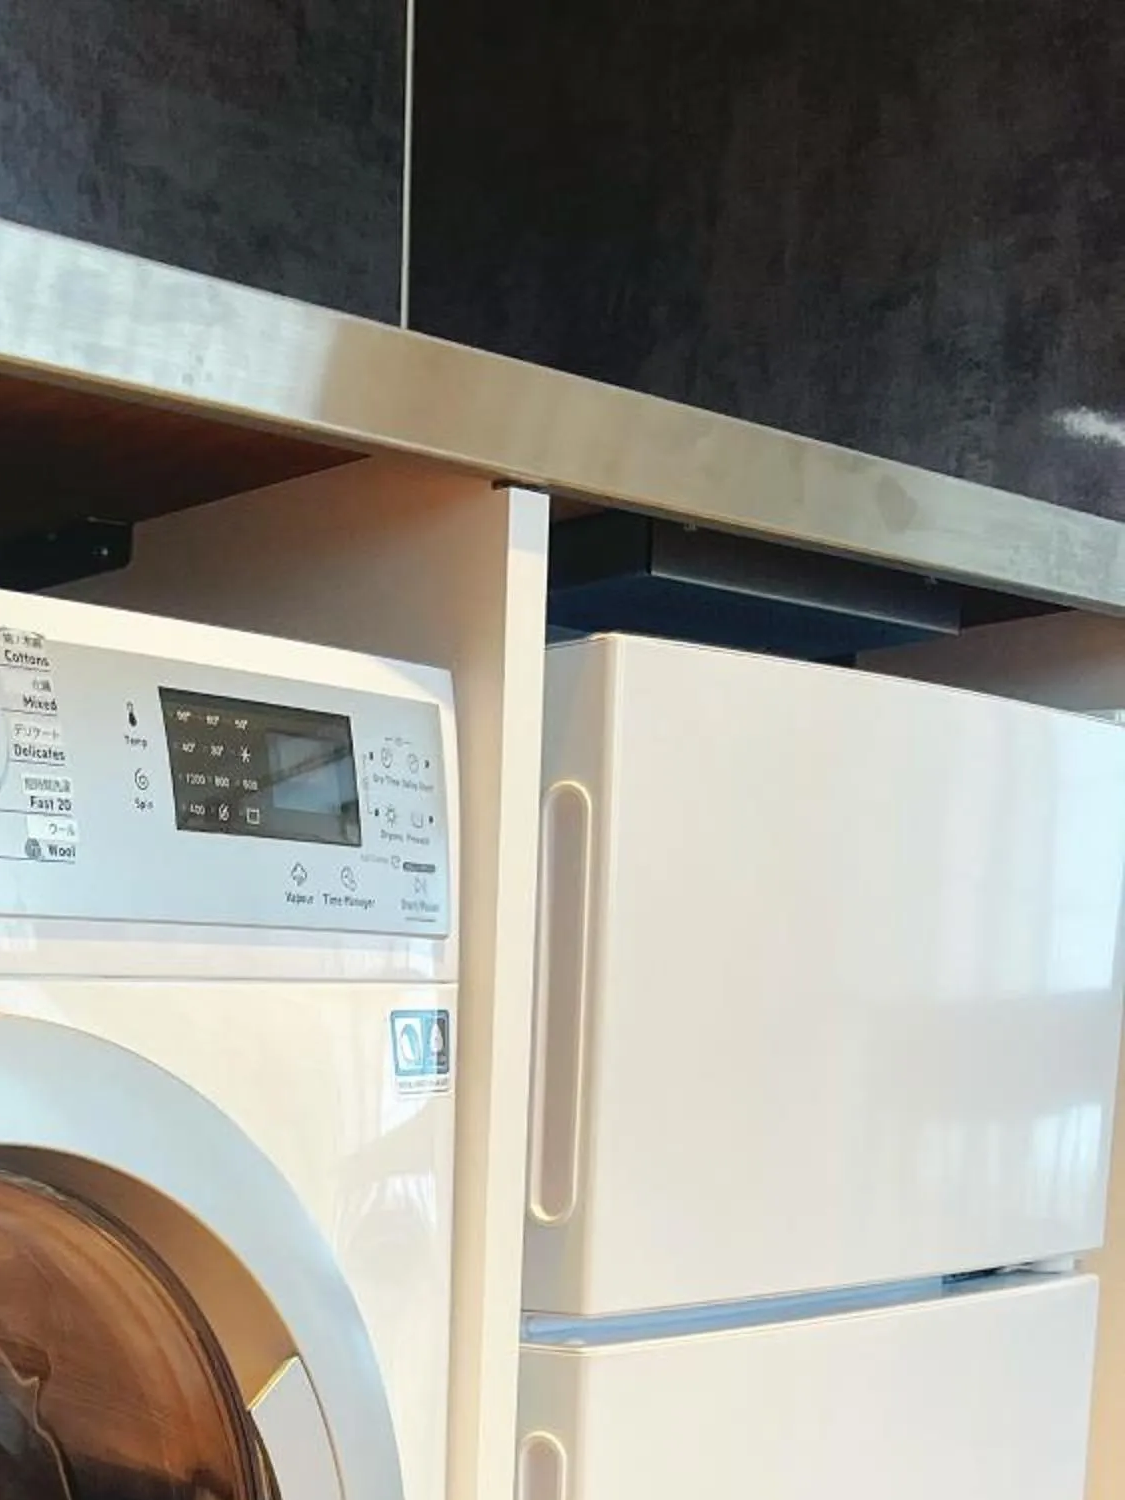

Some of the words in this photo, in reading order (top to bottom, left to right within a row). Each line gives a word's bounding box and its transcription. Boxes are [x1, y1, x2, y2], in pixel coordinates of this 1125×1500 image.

[4, 649, 50, 667] Cottons
[22, 694, 58, 712] Mixed
[14, 723, 60, 740] デリケート
[13, 743, 66, 761] Delicates
[30, 795, 54, 811] Fast
[57, 797, 72, 811] 20
[47, 843, 76, 858] Wool
